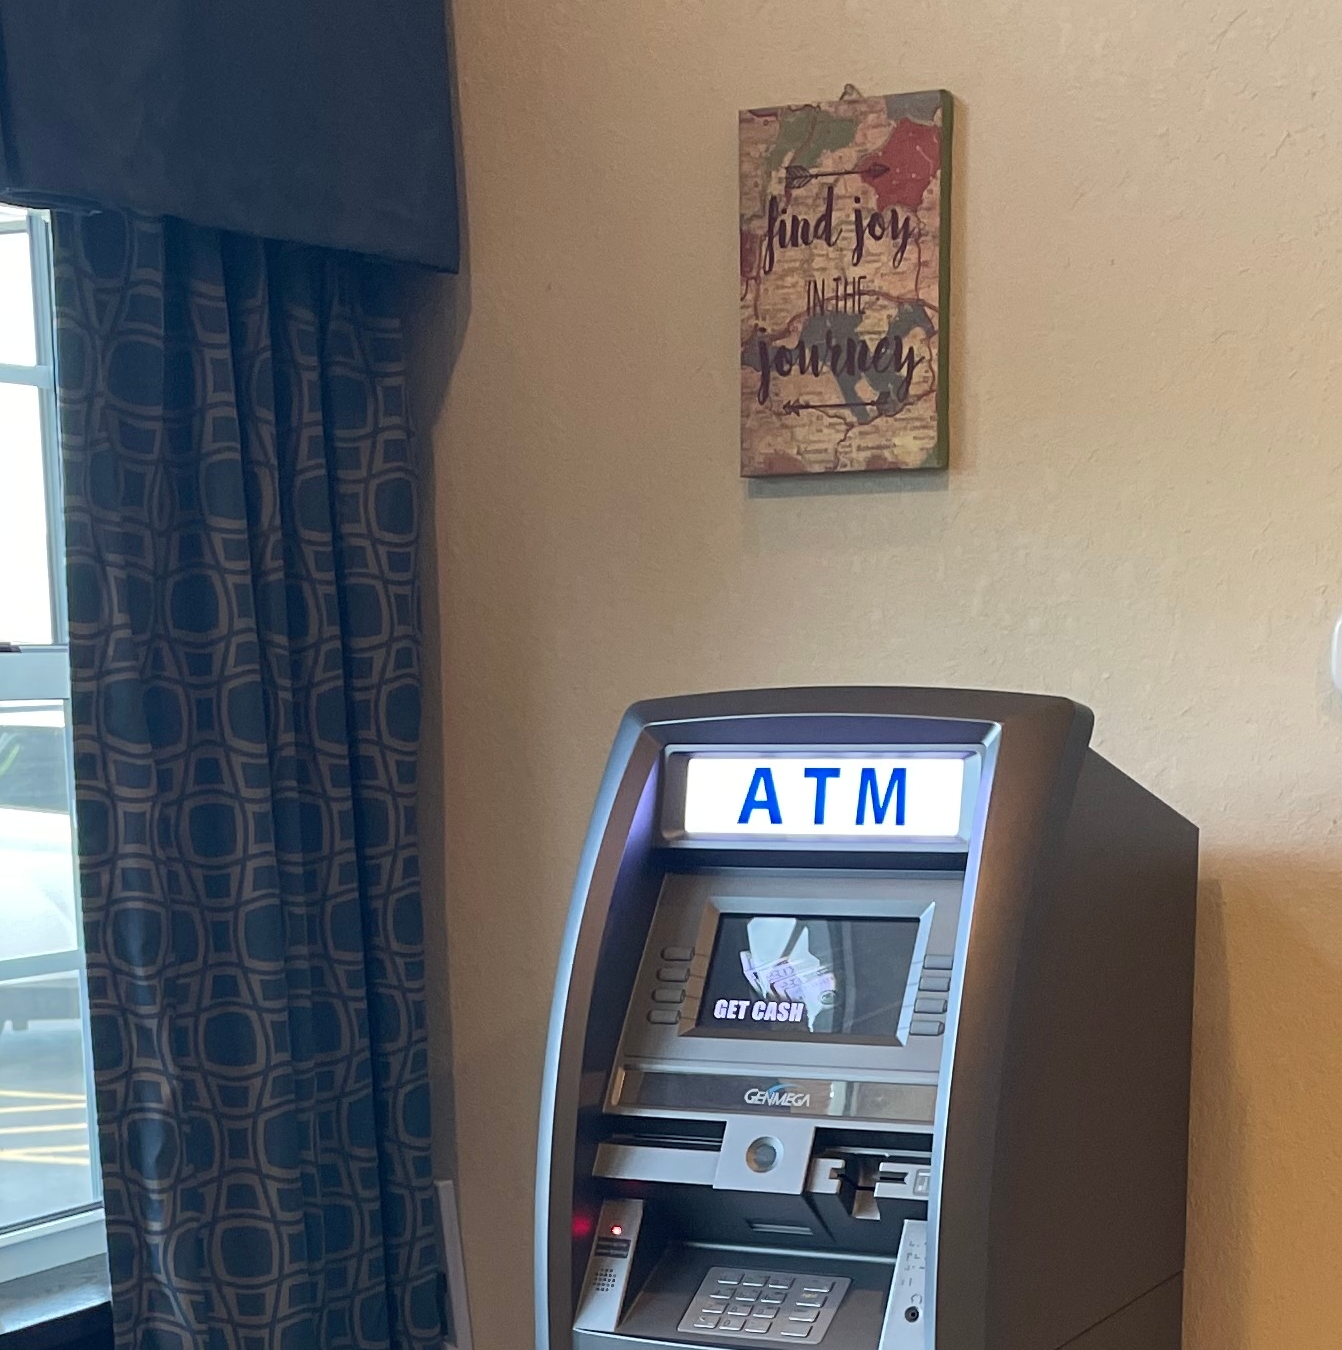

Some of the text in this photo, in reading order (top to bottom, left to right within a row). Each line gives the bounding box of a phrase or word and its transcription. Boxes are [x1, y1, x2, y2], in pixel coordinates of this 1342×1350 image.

[763, 186, 919, 274] find joy
[807, 275, 867, 316] IN THE
[756, 327, 924, 405] journey
[737, 767, 907, 826] ATM
[713, 998, 804, 1022] GET CASH
[744, 1088, 810, 1108] GENMEGA
